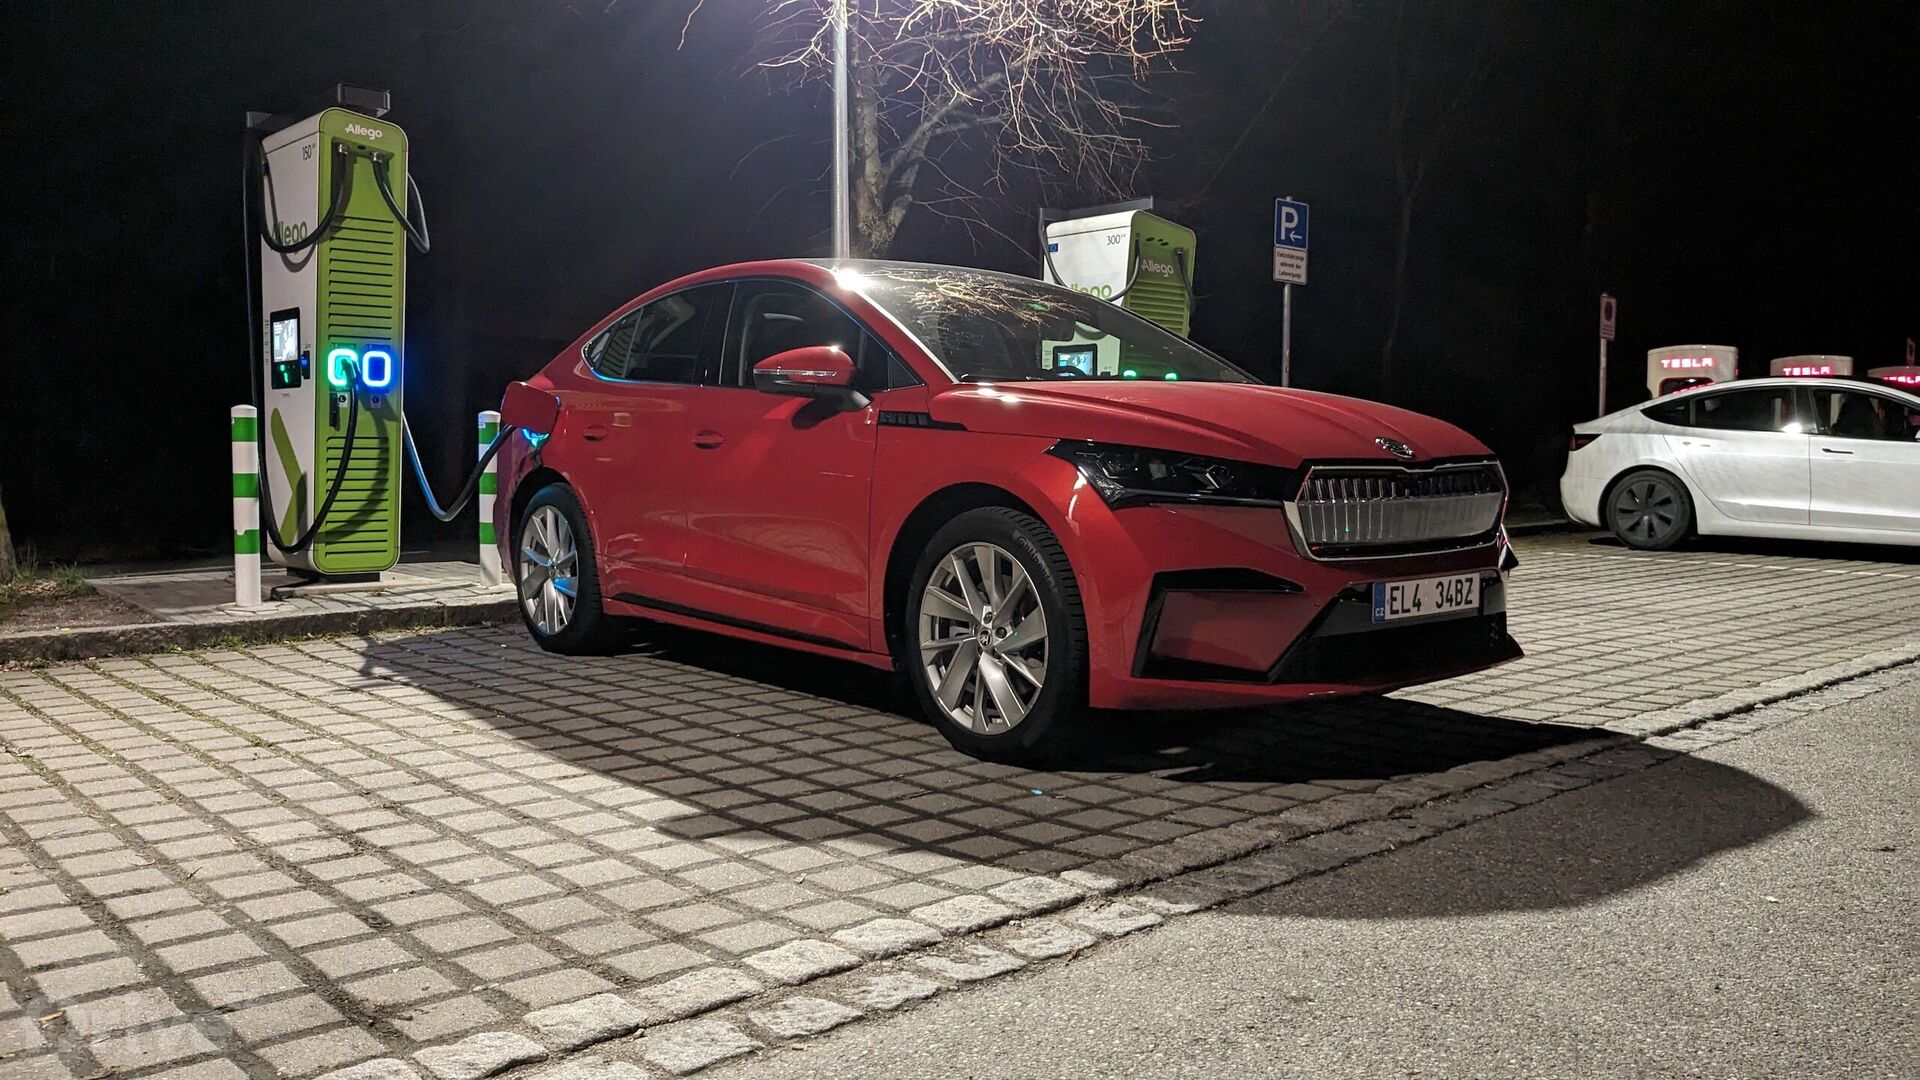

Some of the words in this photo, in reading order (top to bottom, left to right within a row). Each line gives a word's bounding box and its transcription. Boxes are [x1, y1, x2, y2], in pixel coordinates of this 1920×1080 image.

[345, 123, 383, 140] Allego
[302, 144, 312, 161] 150
[1280, 206, 1298, 240] P
[1106, 233, 1121, 246] 300
[1140, 259, 1174, 277] Allego
[1661, 357, 1713, 369] TESLA
[1783, 366, 1831, 377] TESLA
[1390, 580, 1422, 615] EL4
[1435, 577, 1473, 609] 34BZ
[1375, 607, 1384, 616] CZ
